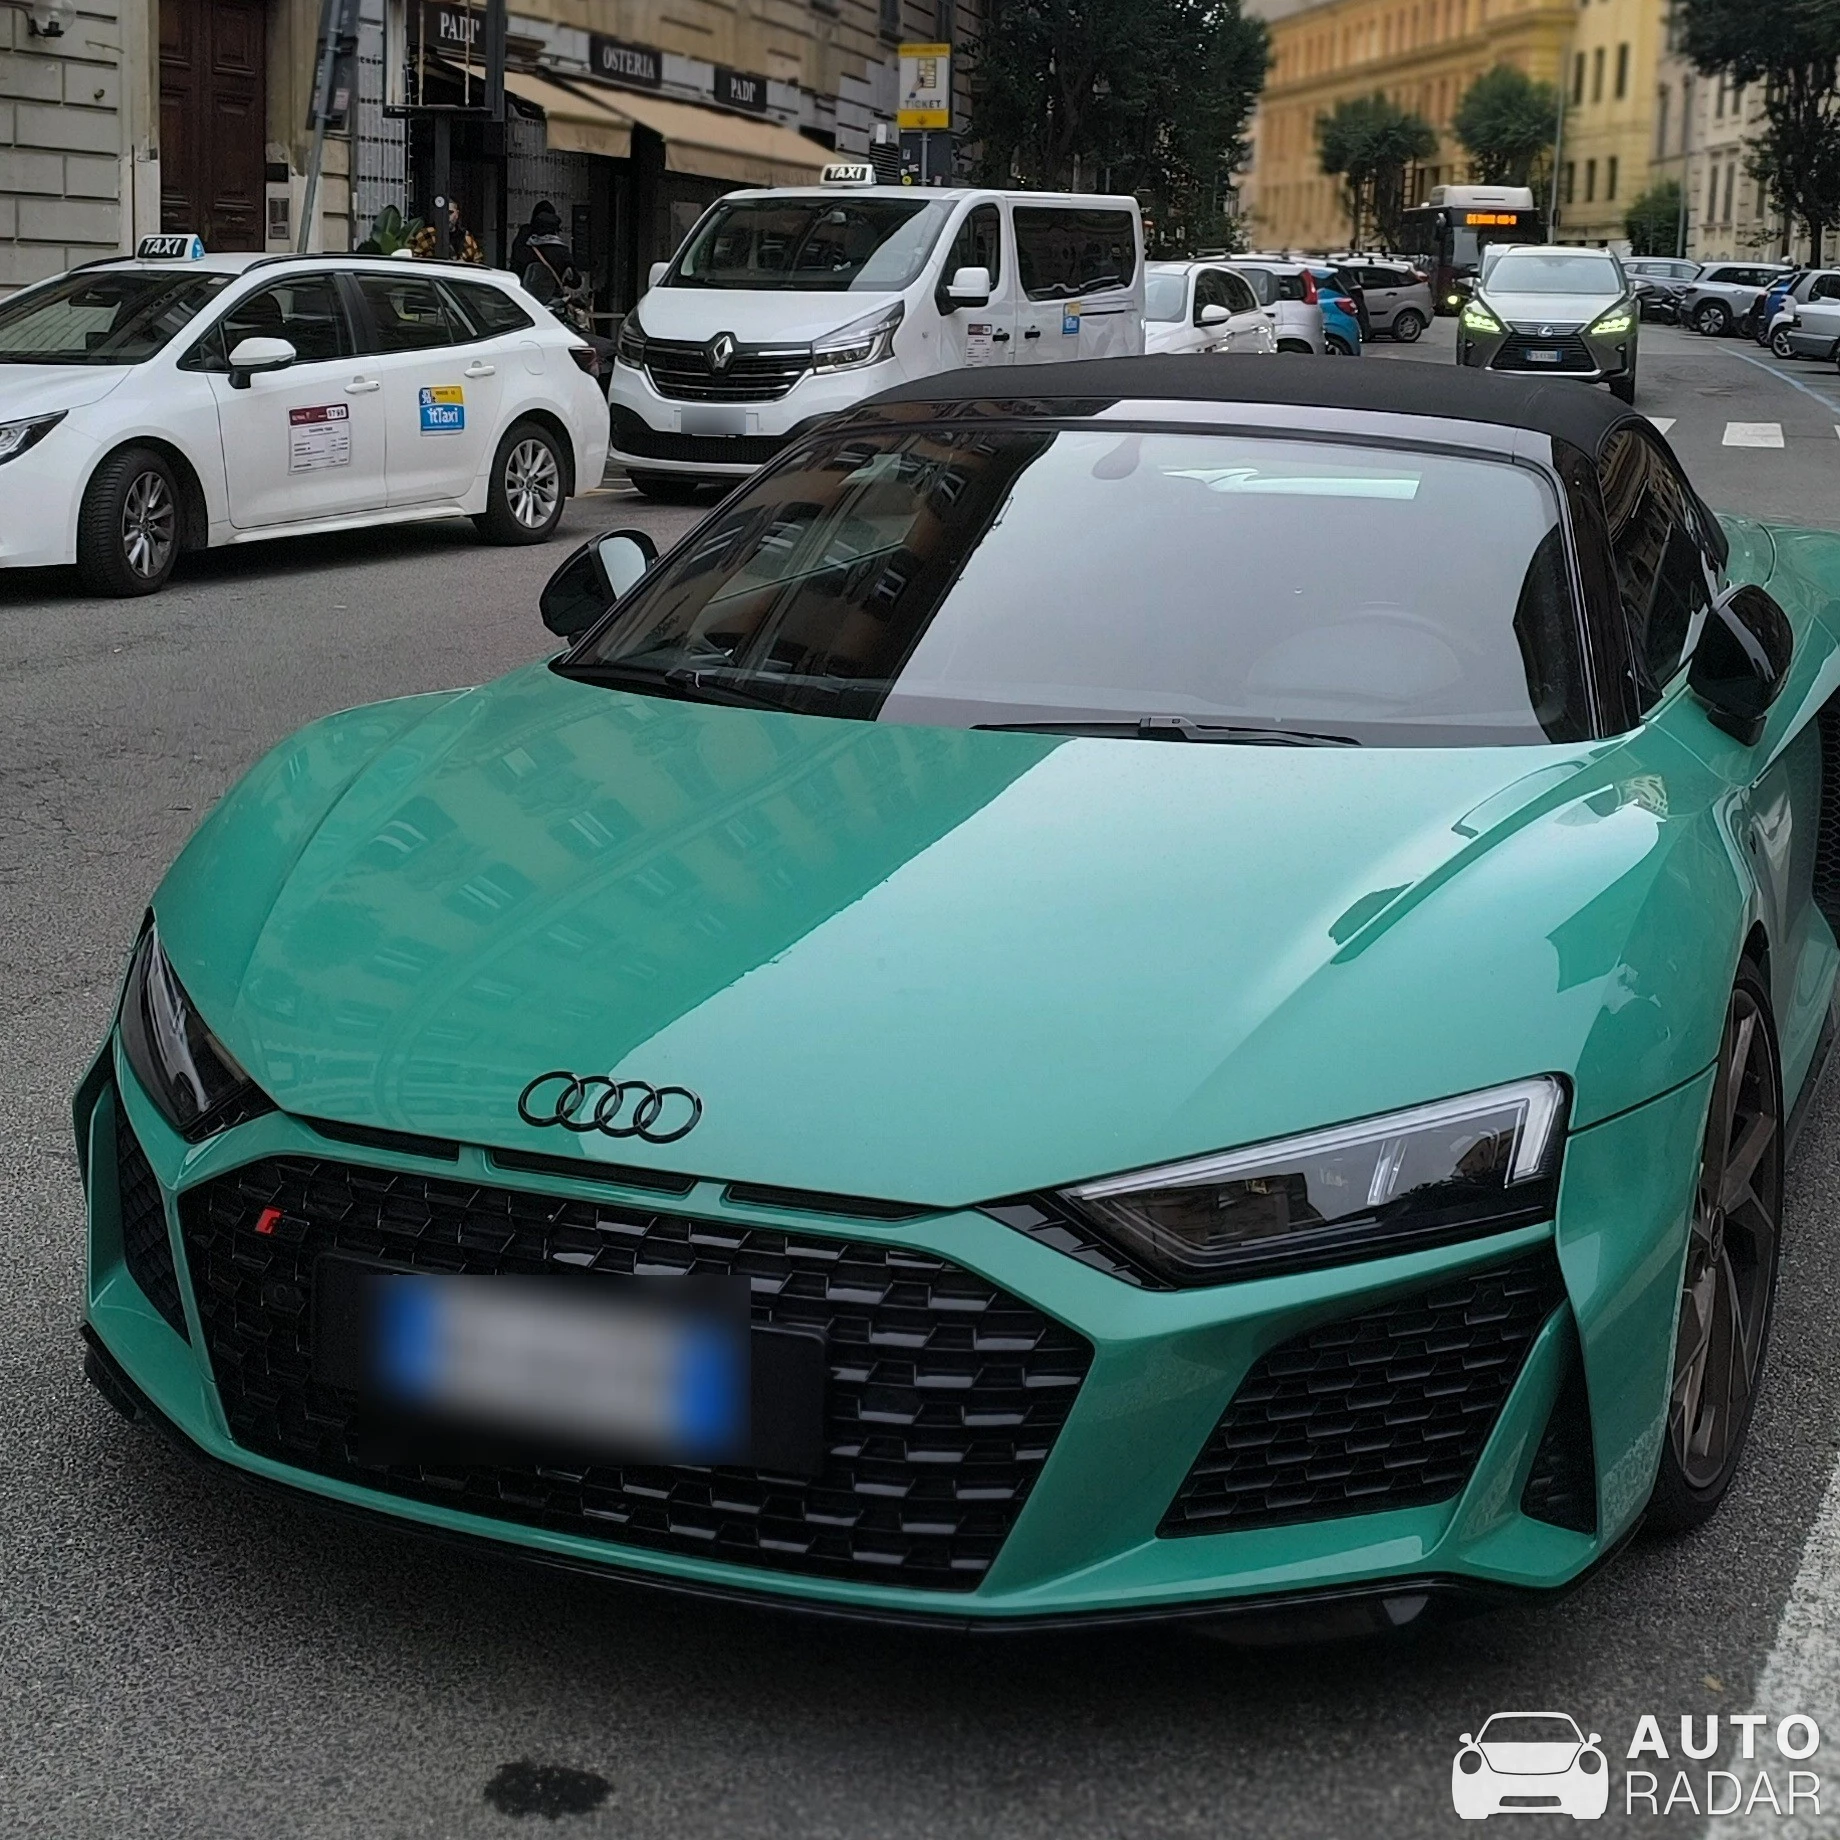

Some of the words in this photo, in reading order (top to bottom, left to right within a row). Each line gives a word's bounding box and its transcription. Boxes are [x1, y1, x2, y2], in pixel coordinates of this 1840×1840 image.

[602, 46, 655, 79] OSTERIA
[905, 99, 942, 109] TICKET
[830, 167, 863, 179] TAXI
[144, 238, 181, 255] TAXI
[427, 407, 459, 424] itTaxi
